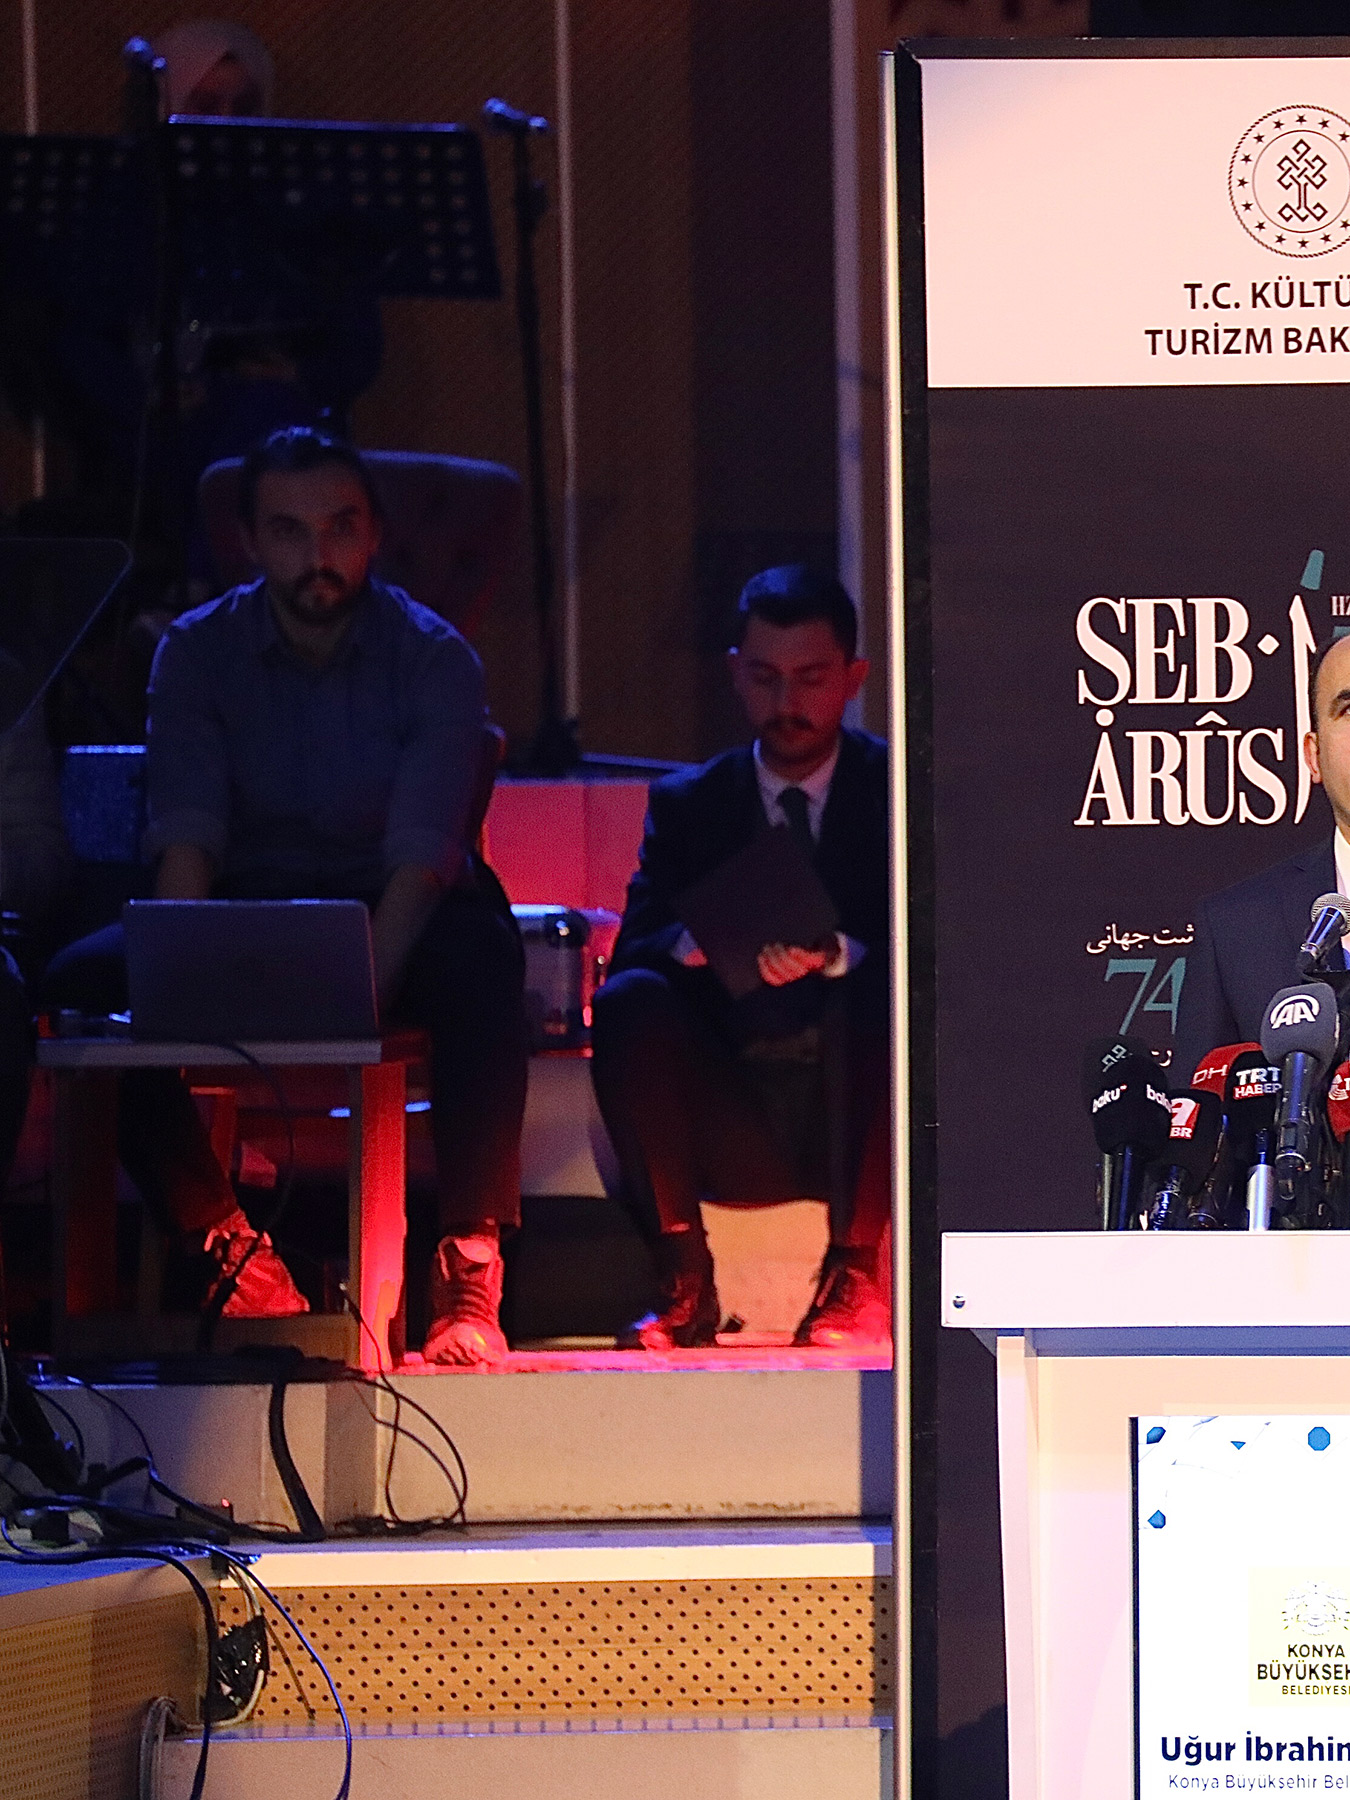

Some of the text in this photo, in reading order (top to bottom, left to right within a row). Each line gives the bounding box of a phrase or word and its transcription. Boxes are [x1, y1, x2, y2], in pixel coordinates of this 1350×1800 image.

[1184, 282, 1241, 310] T.C.
[1145, 322, 1273, 356] TURİZM
[1236, 1067, 1281, 1086] TRT
[1287, 1643, 1346, 1658] KONYA
[1161, 1735, 1236, 1766] Uğur
[1168, 1774, 1219, 1791] Konya
